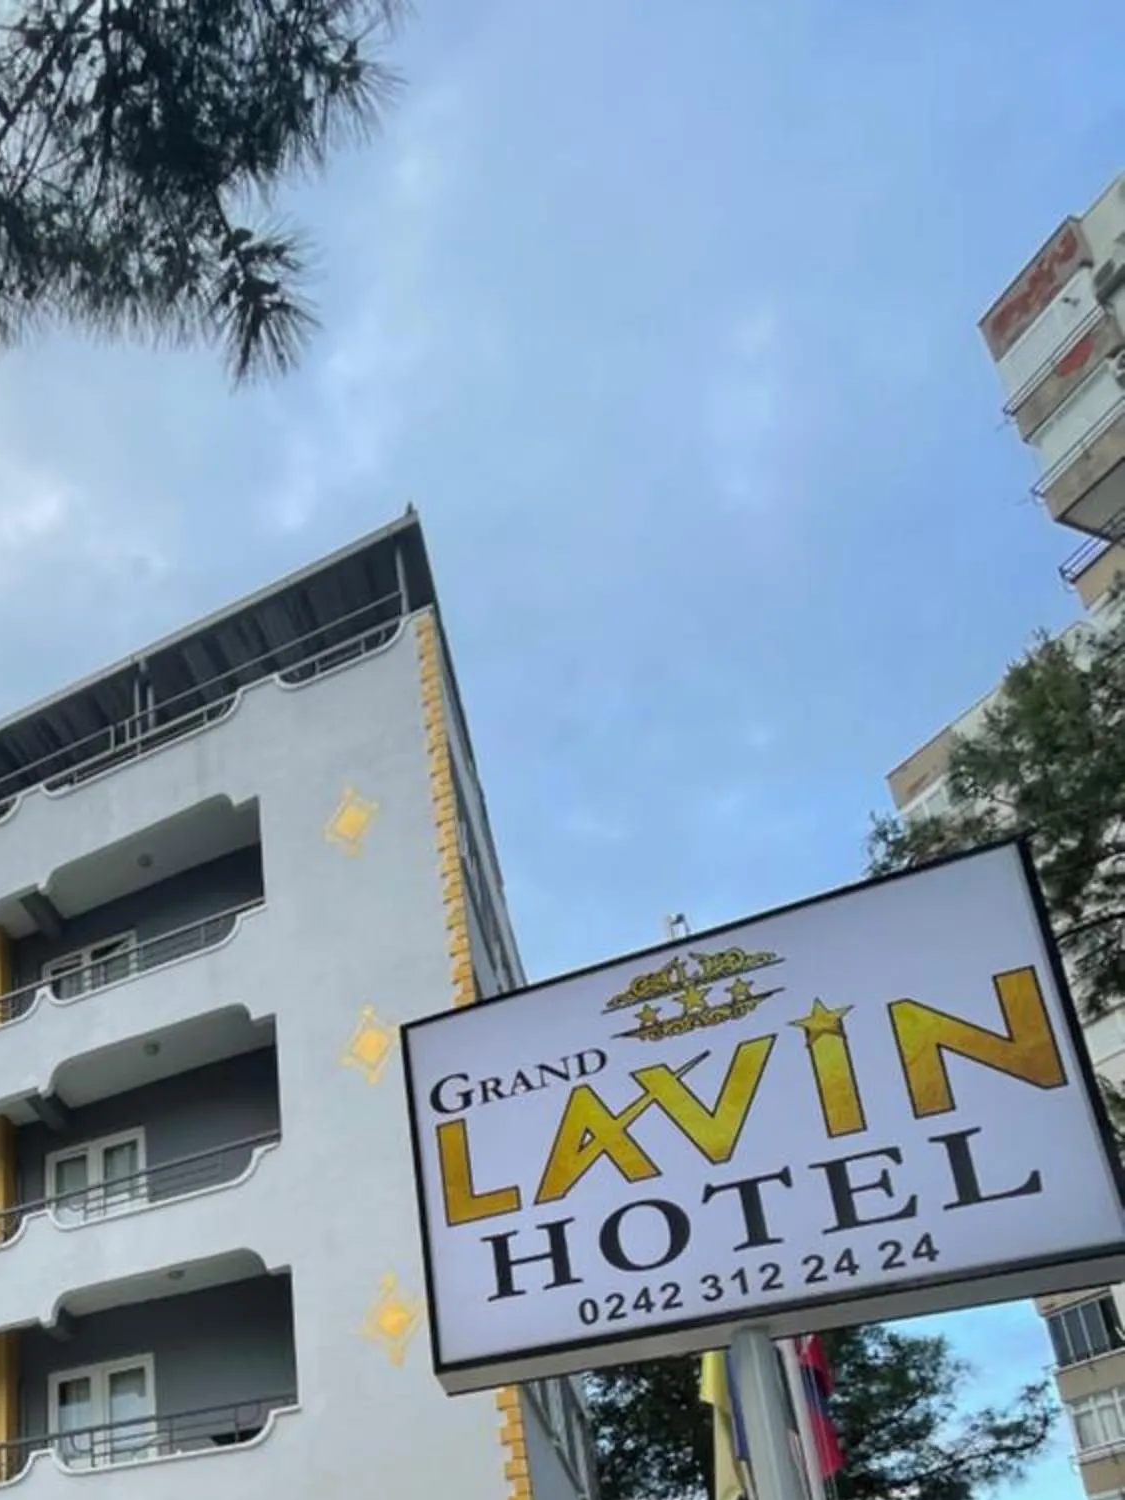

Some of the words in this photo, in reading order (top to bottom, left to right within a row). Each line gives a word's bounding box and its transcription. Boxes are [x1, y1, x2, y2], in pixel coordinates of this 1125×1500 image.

[428, 1047, 608, 1115] GRAND
[480, 1126, 1043, 1303] HOTEL
[577, 1282, 683, 1326] 0242
[700, 1263, 784, 1303] 312
[801, 1247, 862, 1283] 24
[877, 1232, 940, 1269] 24
